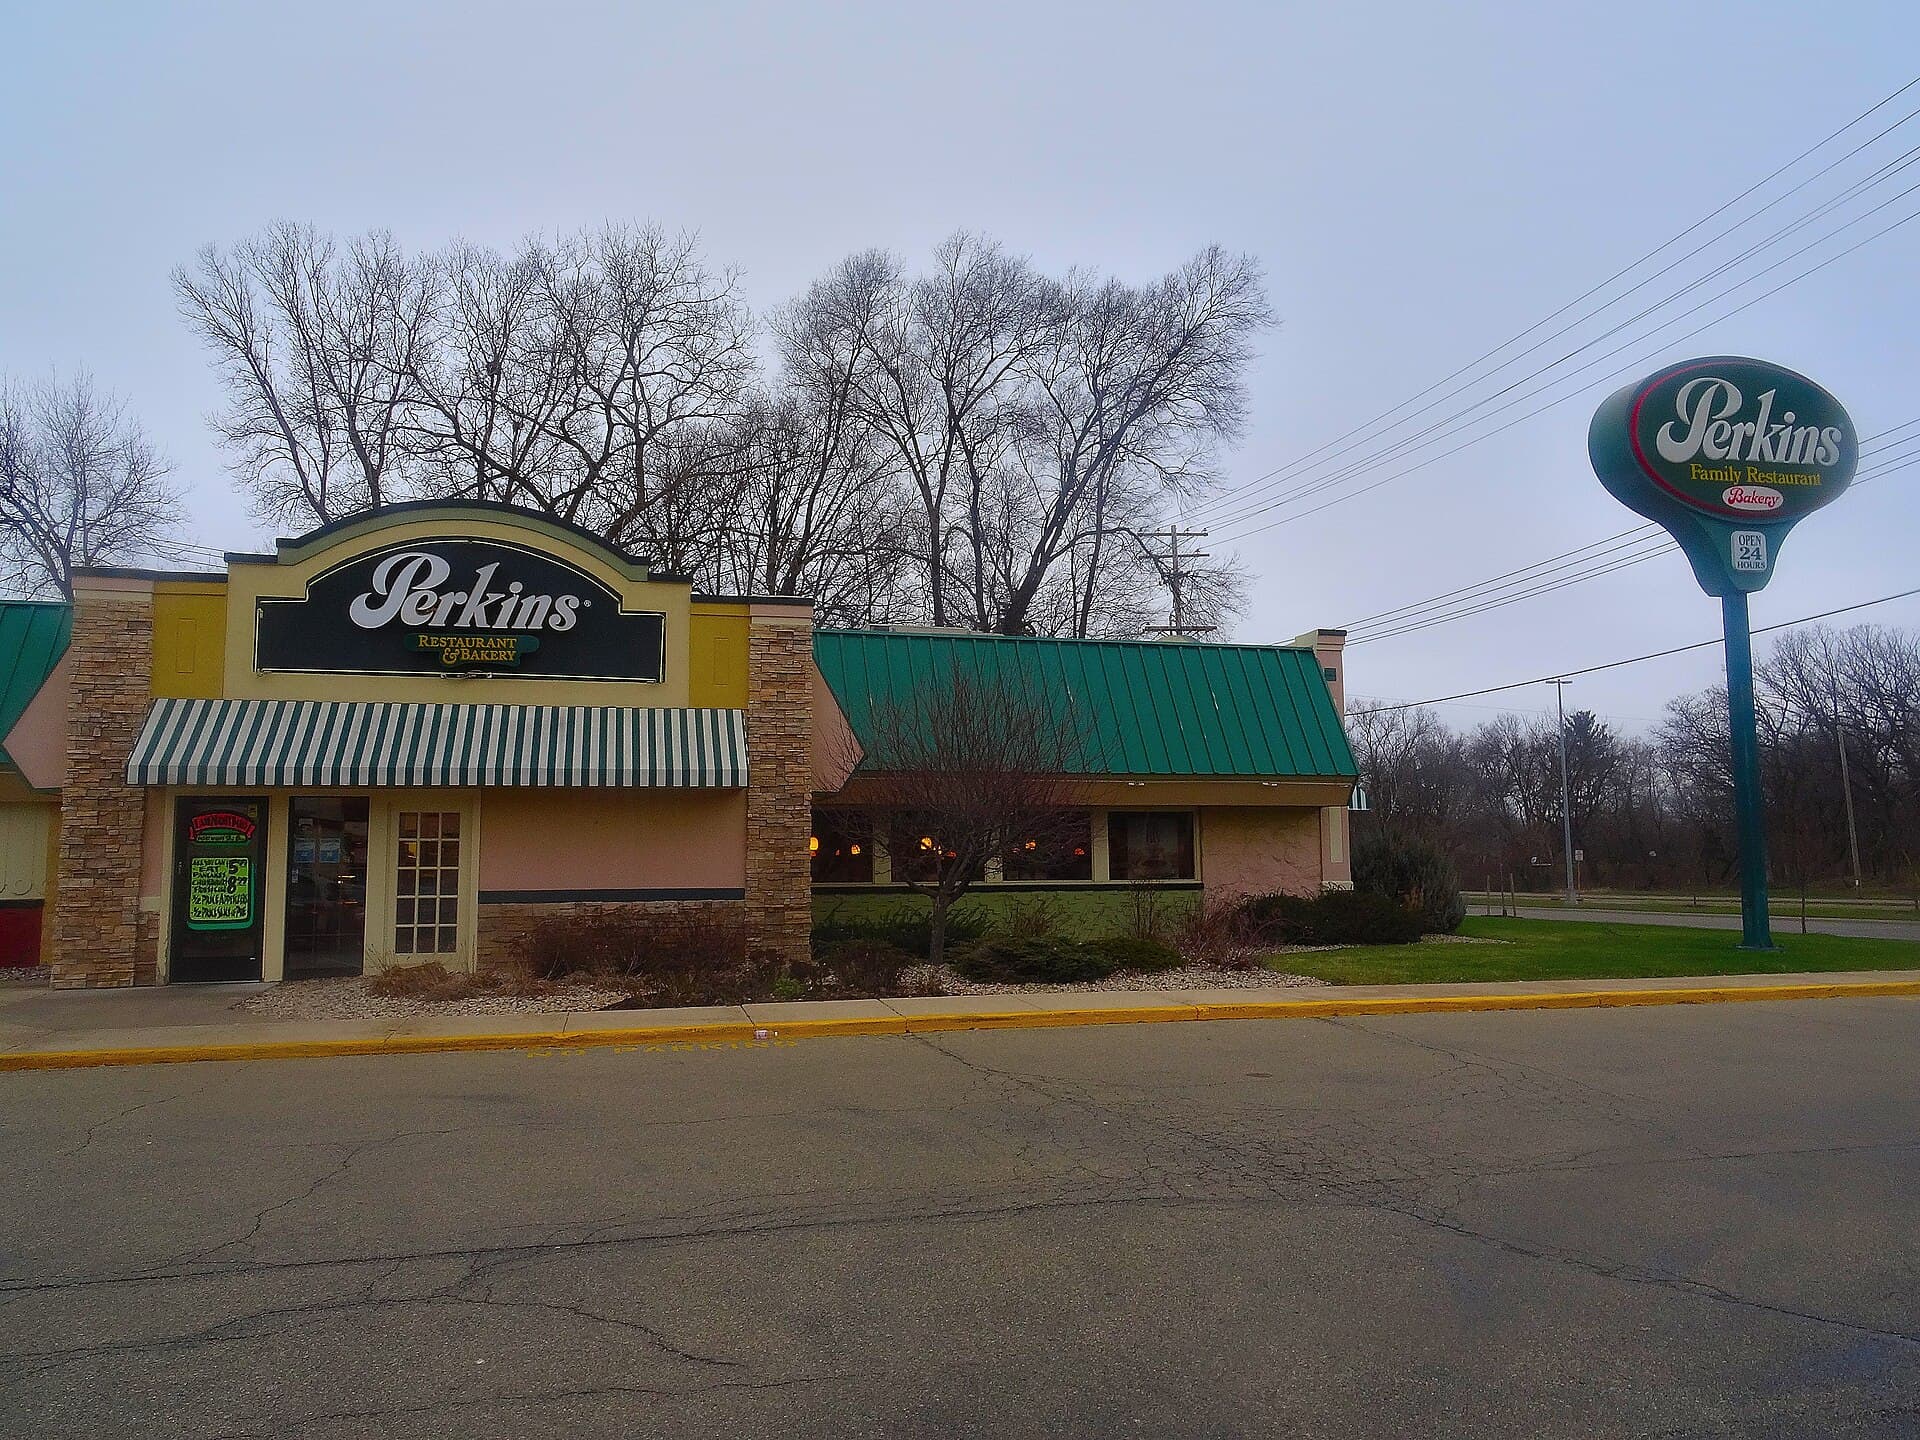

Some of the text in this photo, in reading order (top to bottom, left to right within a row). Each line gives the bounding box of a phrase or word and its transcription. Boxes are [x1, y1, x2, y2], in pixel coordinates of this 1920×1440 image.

[1656, 377, 1842, 467] Perkins
[1689, 463, 1822, 486] Family Restaurant
[1727, 487, 1781, 508] Bakery
[1738, 534, 1762, 547] OPEN
[1739, 547, 1762, 561] 24
[1736, 560, 1766, 570] HOURS
[349, 551, 580, 632] Perkins
[417, 634, 518, 650] RESTAURANT
